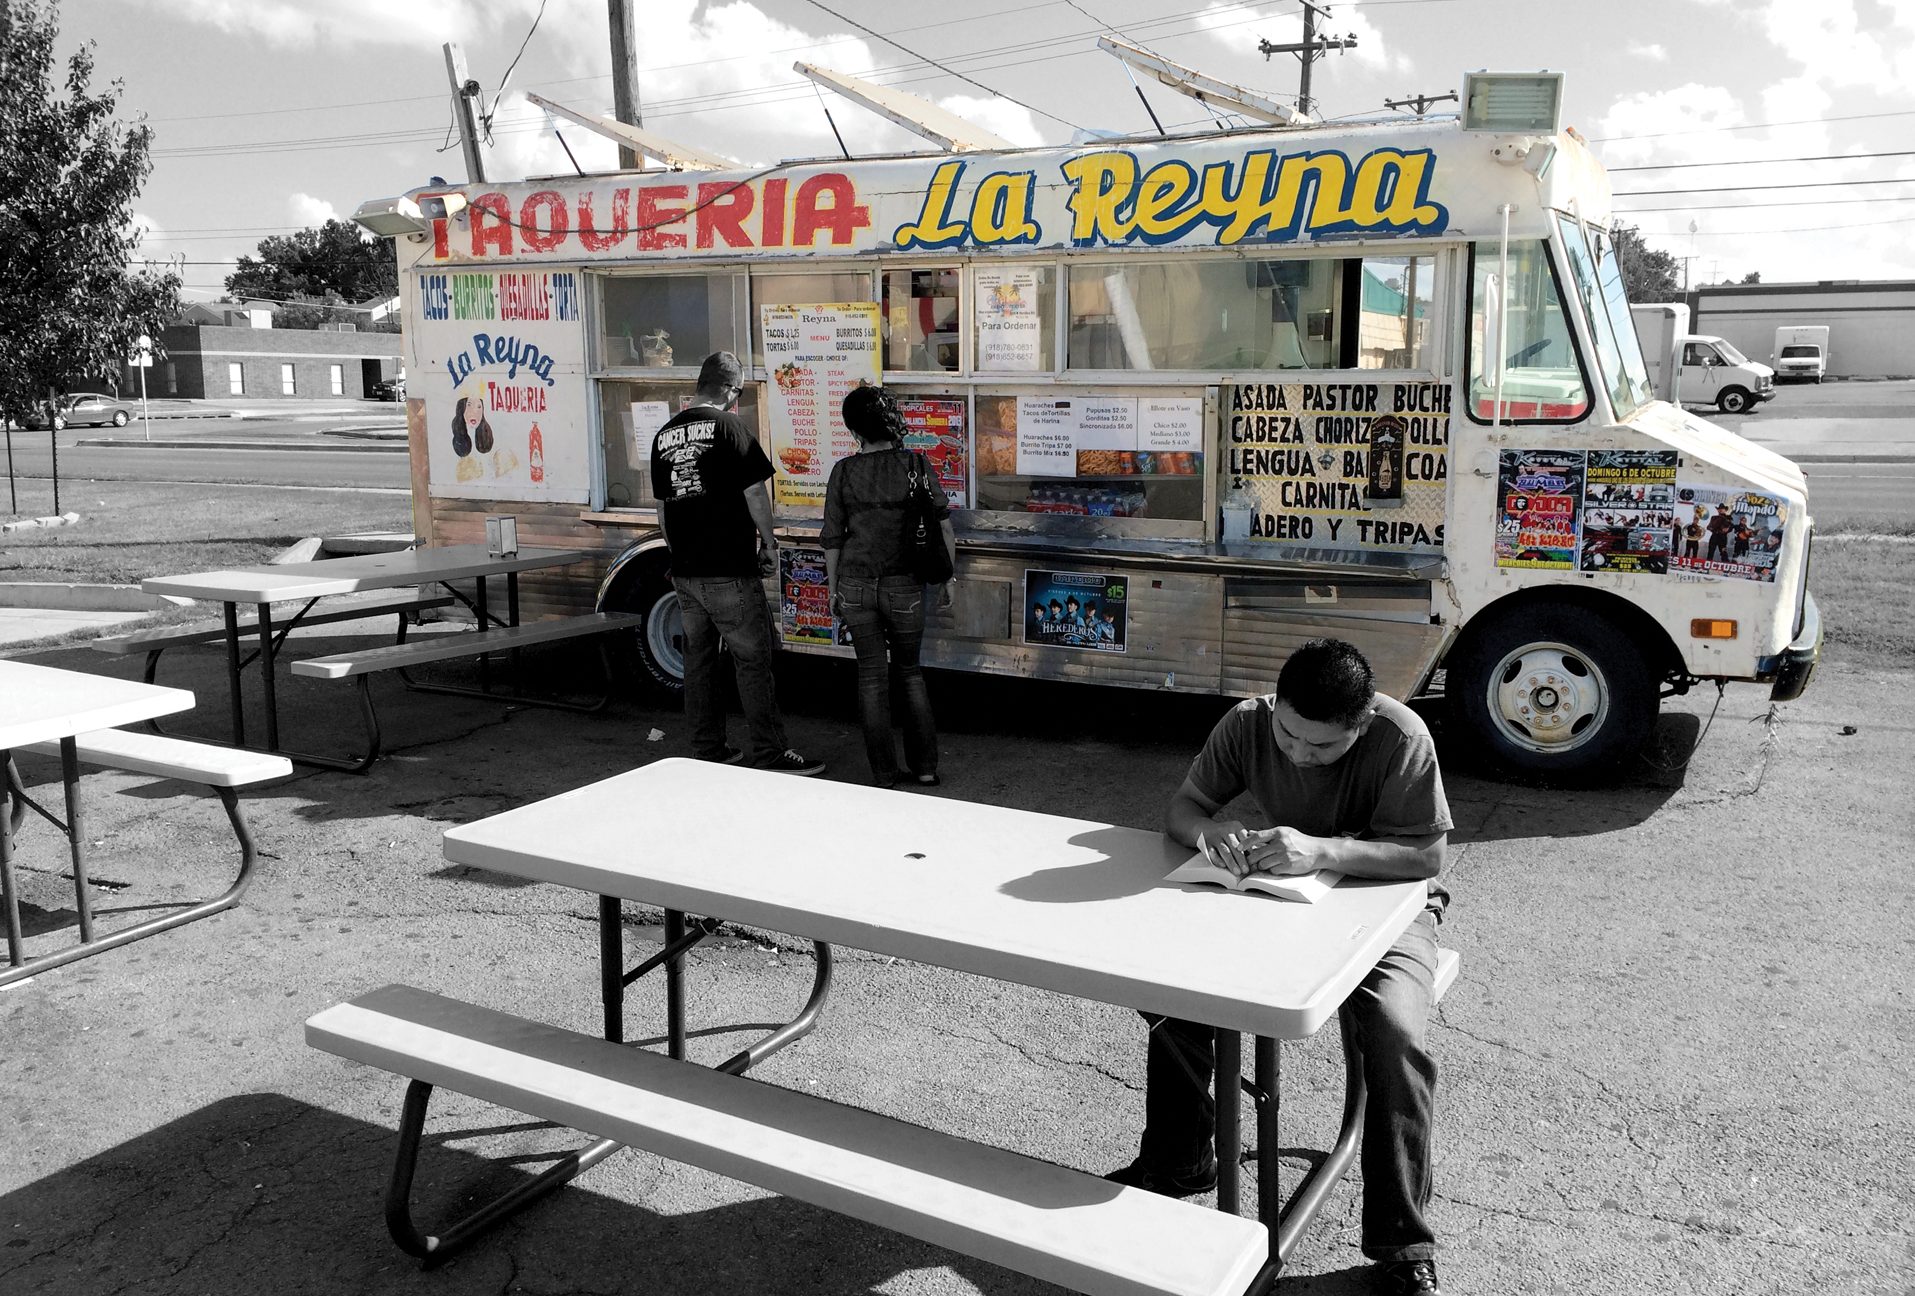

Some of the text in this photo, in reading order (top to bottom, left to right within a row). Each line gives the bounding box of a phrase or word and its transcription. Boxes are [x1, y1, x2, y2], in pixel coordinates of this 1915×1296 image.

[416, 147, 1450, 258] TAQUERIA La Reyna
[420, 274, 449, 320] TACOS
[453, 274, 495, 320] BURRITOS
[500, 273, 549, 321] QUESADILLAS
[802, 315, 836, 324] Reyna
[982, 322, 1037, 330] Para Ordenar
[766, 329, 785, 338] TACOS
[836, 329, 862, 338] BURRITOS
[767, 342, 787, 352] TORTAS
[836, 342, 866, 351] QUESADILLAS
[446, 333, 555, 389] La Reyna
[488, 381, 547, 413] TAQUERIA
[1233, 385, 1287, 411] ASADA
[1303, 385, 1379, 412] PASTOR
[1232, 416, 1304, 444] CABEZA
[658, 428, 686, 452] CANCER
[687, 422, 716, 442] SUCKS!
[787, 448, 818, 456] CHORIZO
[1231, 449, 1316, 477] LENGUA
[1588, 468, 1676, 478] DOMINGO 6 DE OCTUBRE
[1327, 518, 1343, 541] Y
[1357, 519, 1444, 546] TRIPAS
[1497, 520, 1520, 533] $25
[1682, 558, 1692, 567] 11
[1107, 586, 1125, 599] $15
[783, 604, 797, 615] $25
[1043, 623, 1098, 640] HEREDEROS
